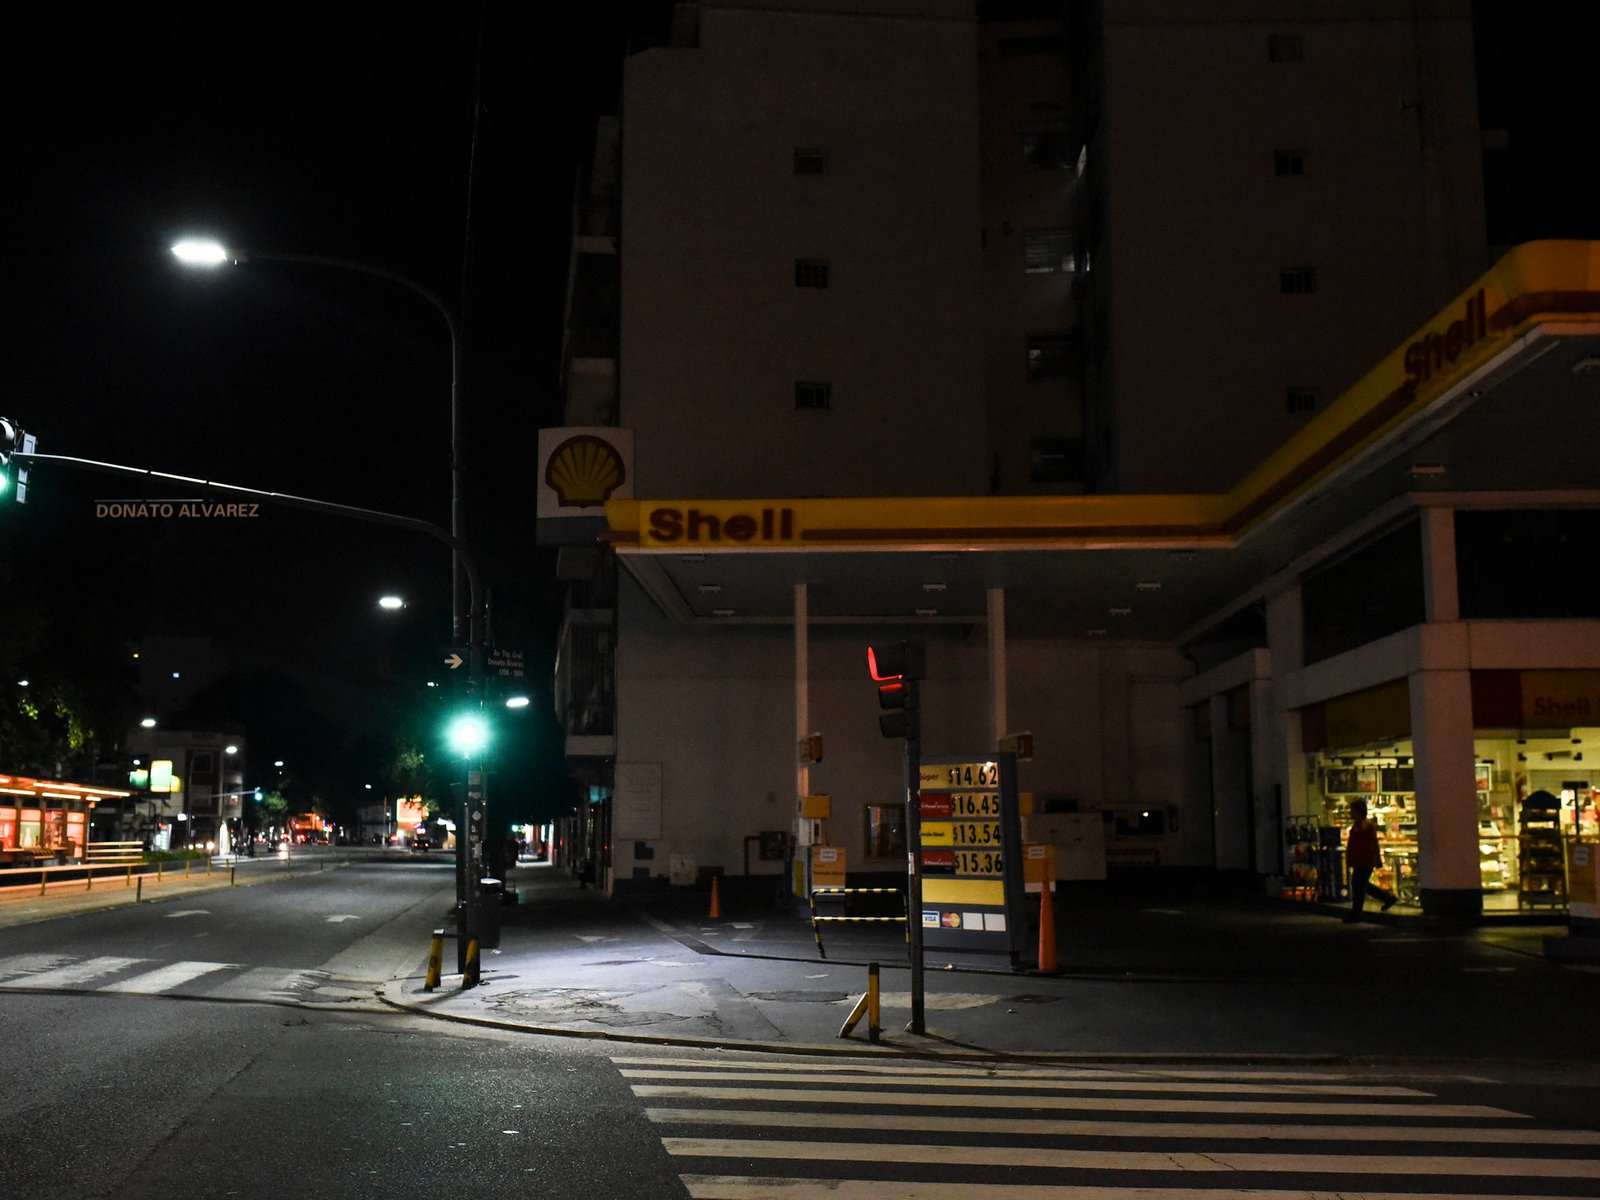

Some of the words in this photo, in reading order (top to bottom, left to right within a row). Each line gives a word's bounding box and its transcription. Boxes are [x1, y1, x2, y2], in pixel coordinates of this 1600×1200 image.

[1404, 287, 1486, 388] Shell
[95, 503, 173, 518] DONATO
[178, 503, 259, 518] ALVAREZ
[648, 507, 793, 542] Shell
[1534, 696, 1590, 716] Shell
[948, 766, 997, 785] $14.62
[951, 795, 999, 814] $16.45
[953, 824, 1001, 843] $13.54
[955, 853, 1003, 873] $15.36
